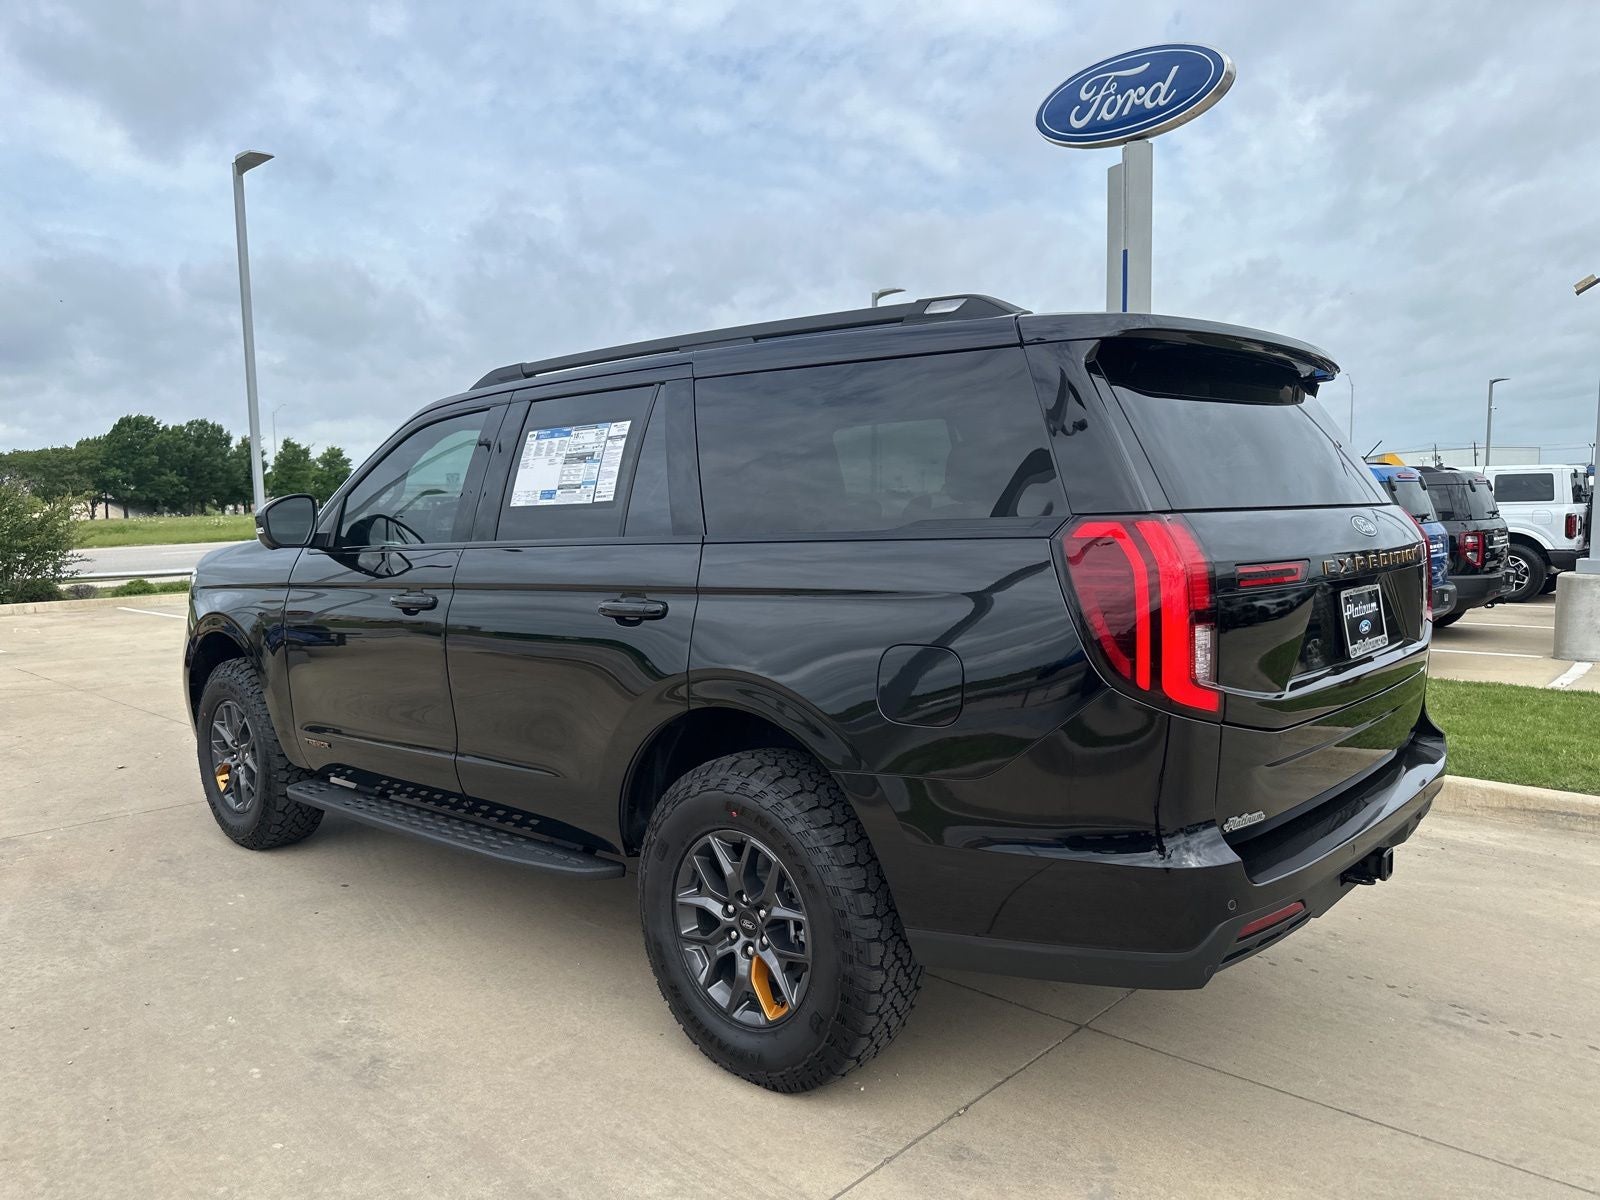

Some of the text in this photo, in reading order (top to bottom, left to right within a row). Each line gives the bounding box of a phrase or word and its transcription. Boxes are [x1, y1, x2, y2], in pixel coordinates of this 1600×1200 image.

[1069, 62, 1179, 128] Ford
[1322, 548, 1418, 576] EXPEDITION
[1344, 601, 1379, 620] Platinum
[1223, 811, 1266, 832] Platinum
